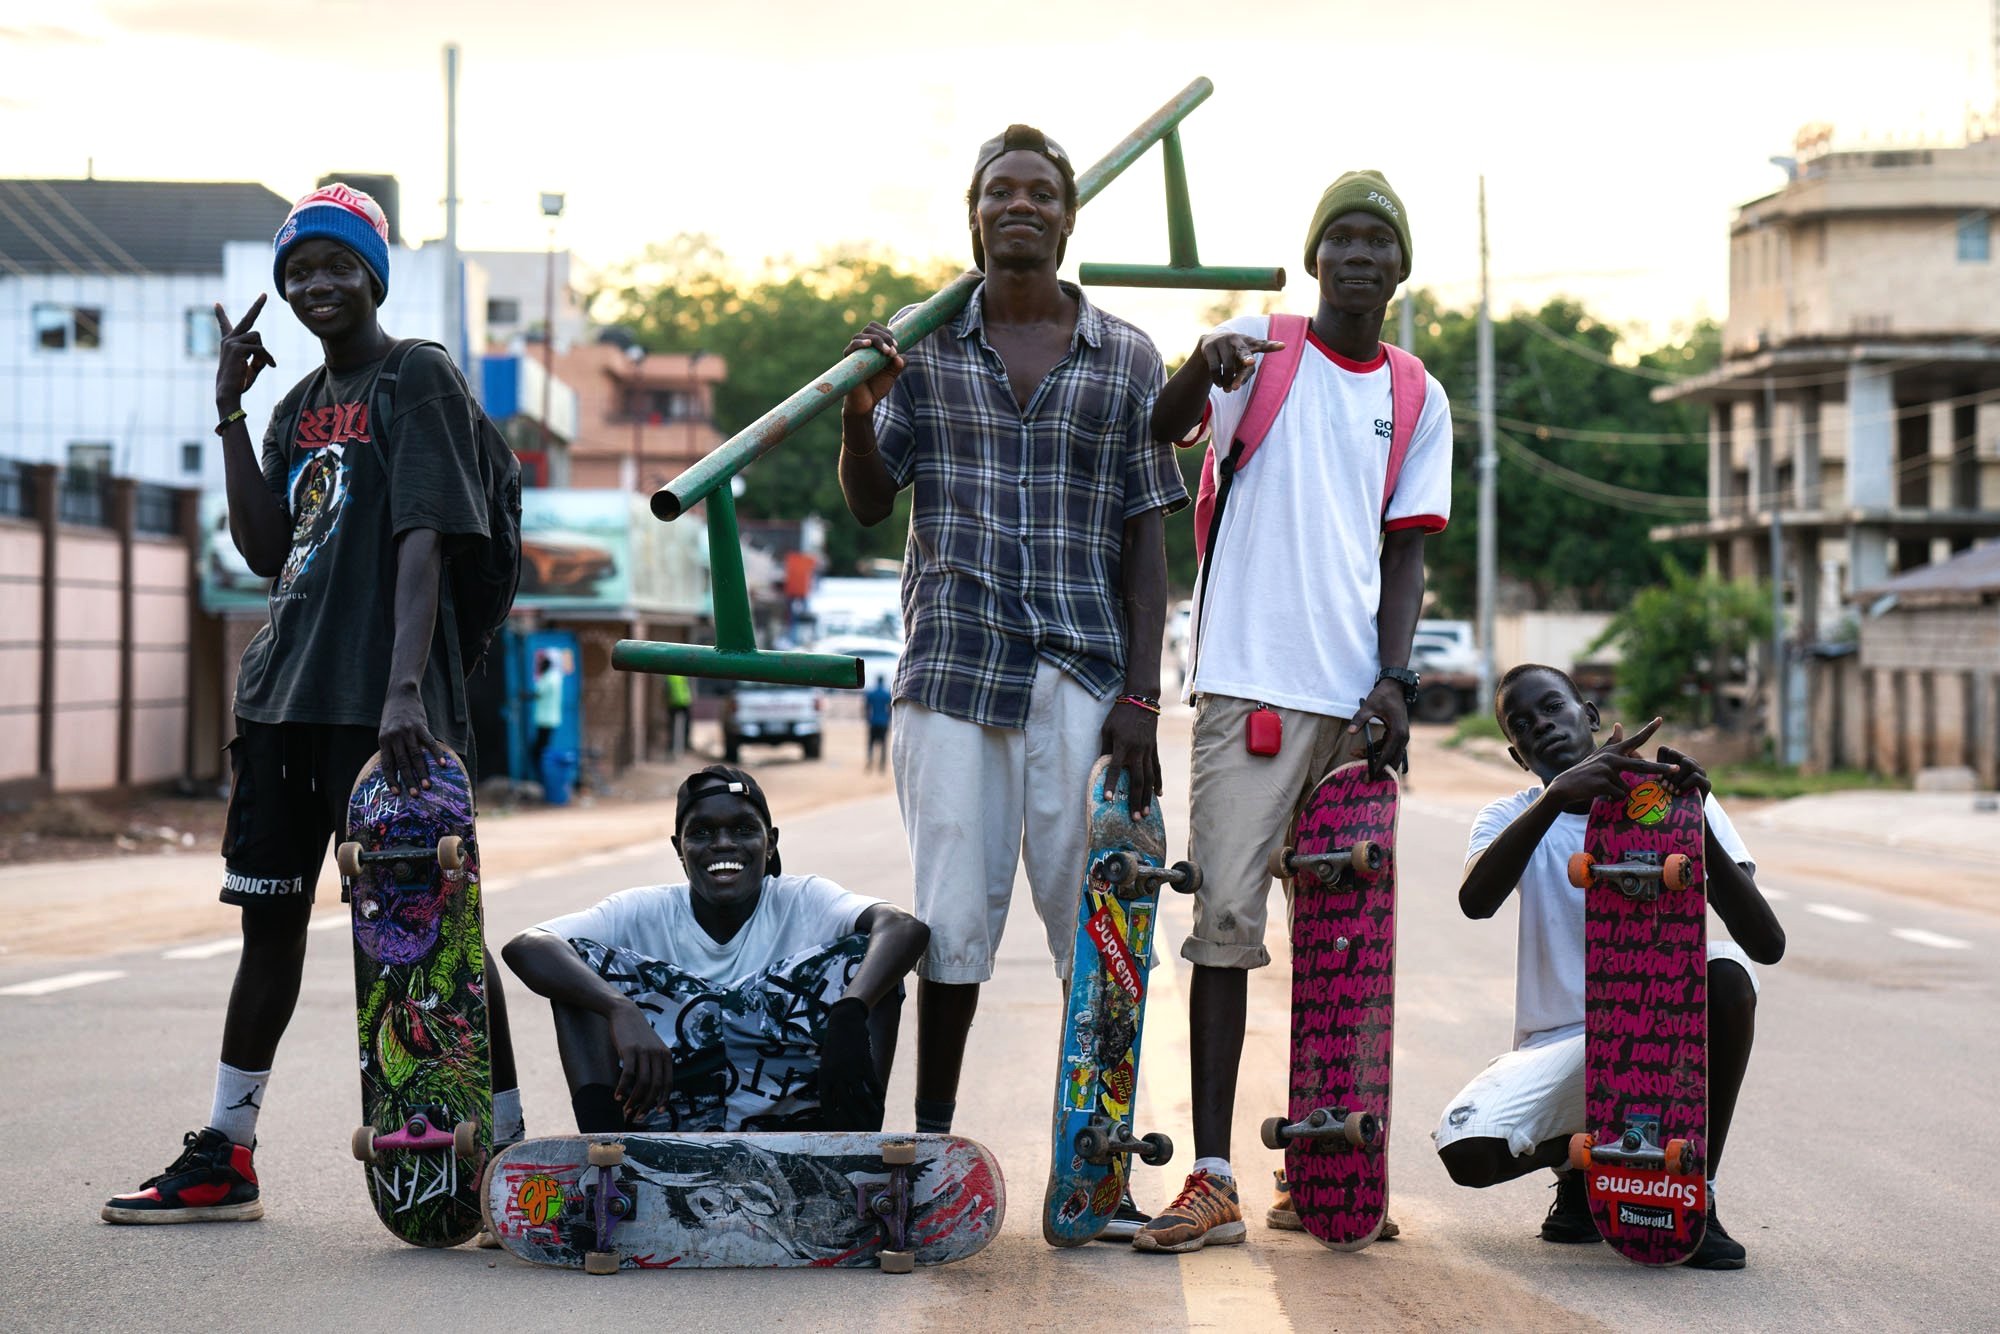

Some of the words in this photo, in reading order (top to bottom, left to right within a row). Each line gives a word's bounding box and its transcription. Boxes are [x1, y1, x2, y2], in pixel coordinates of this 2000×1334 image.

[1095, 913, 1138, 998] Supreme
[1595, 1175, 1698, 1207] Supreme
[1619, 1207, 1674, 1230] THRASHER
